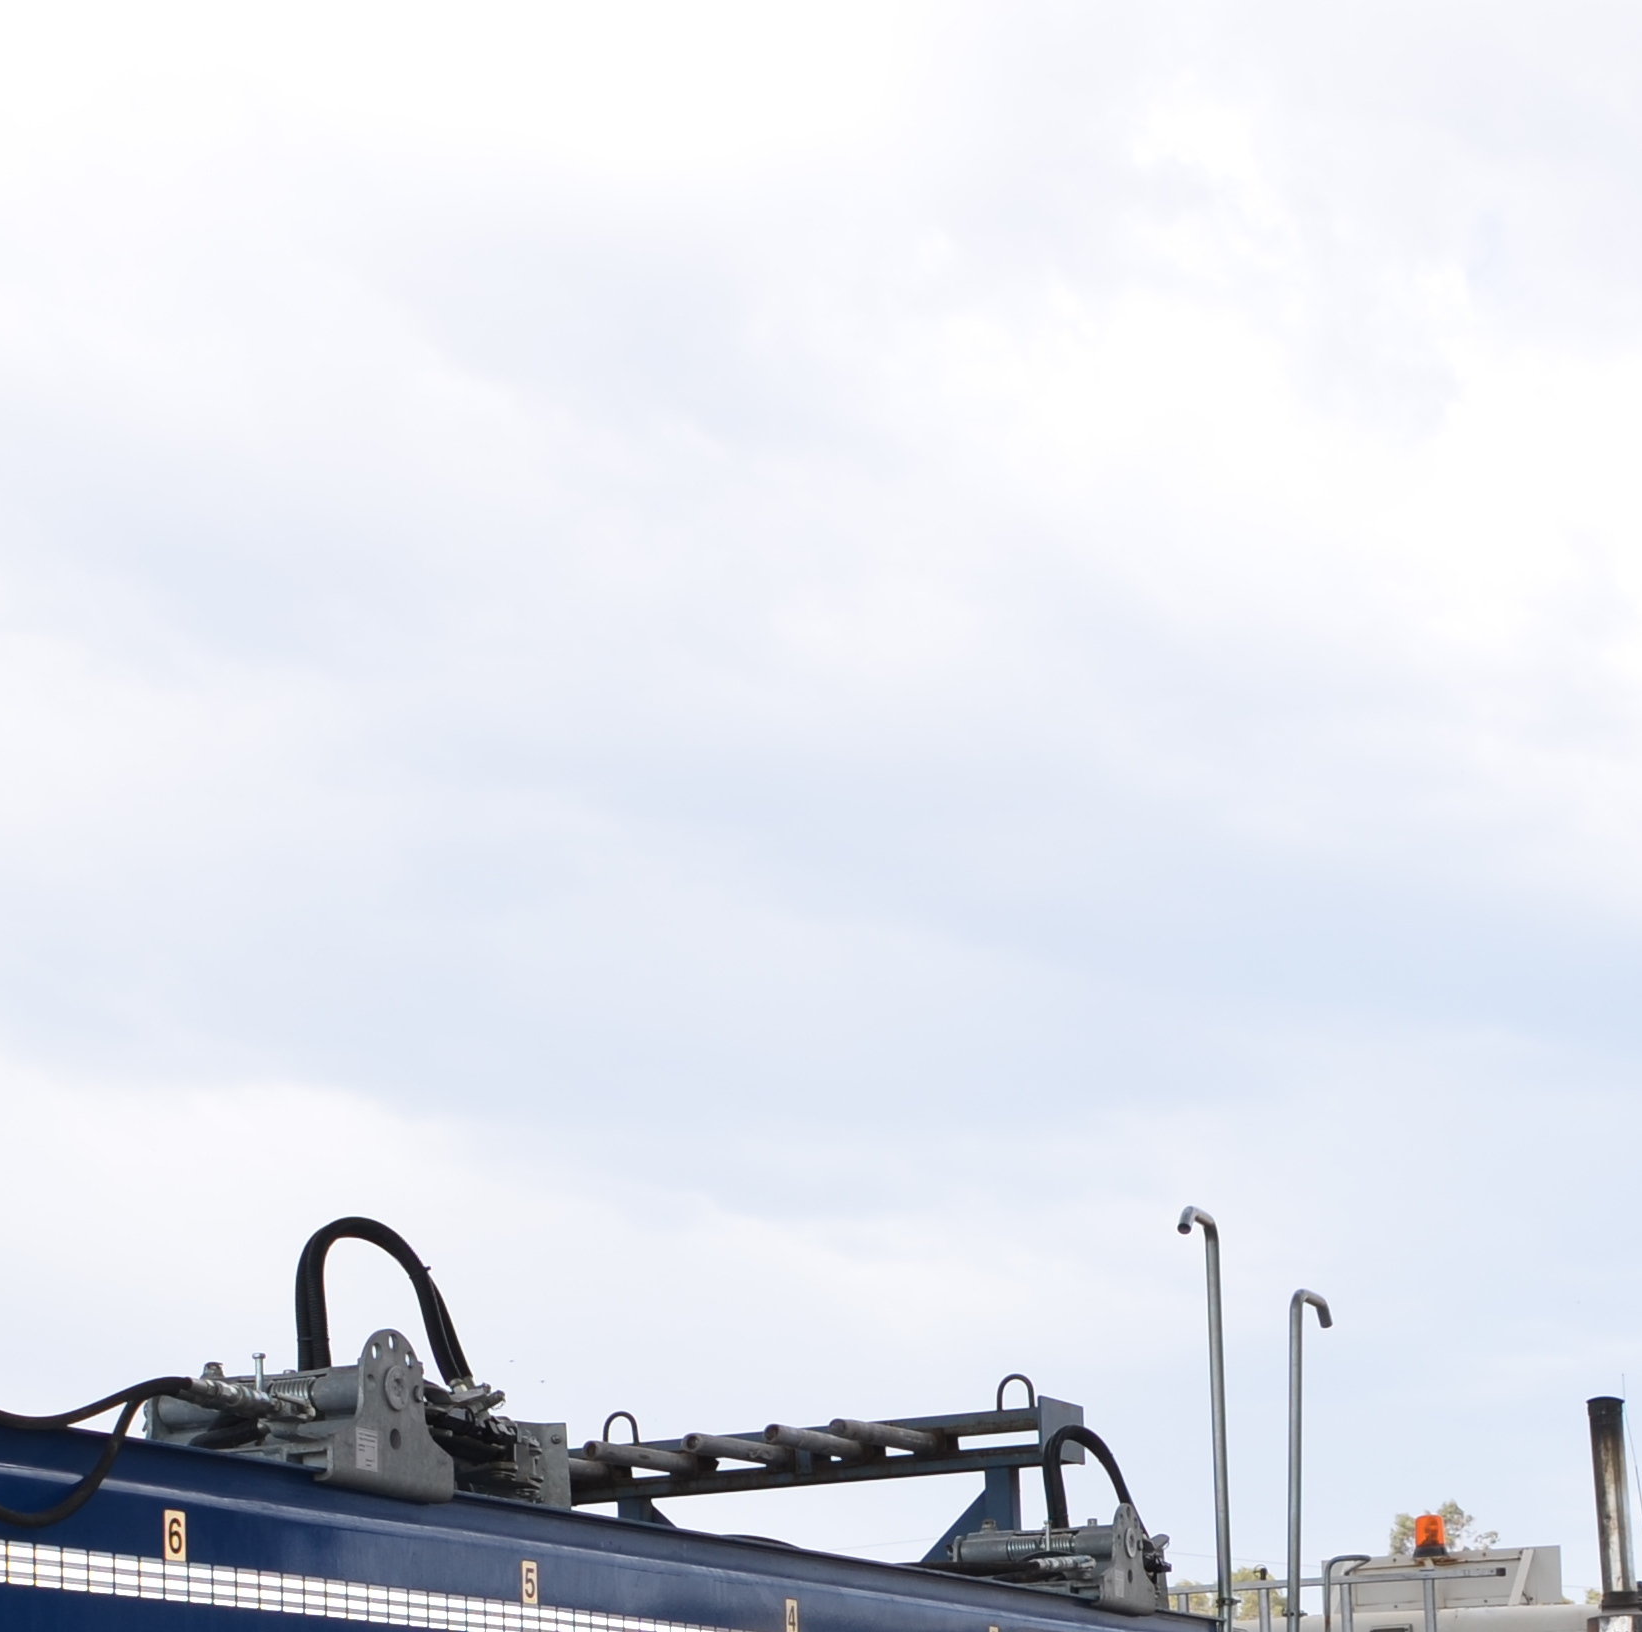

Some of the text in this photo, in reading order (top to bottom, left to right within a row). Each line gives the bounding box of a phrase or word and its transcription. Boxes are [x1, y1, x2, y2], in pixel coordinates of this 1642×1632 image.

[169, 1517, 182, 1554] 6
[525, 1568, 535, 1598] 5
[788, 1606, 796, 1632] 4
